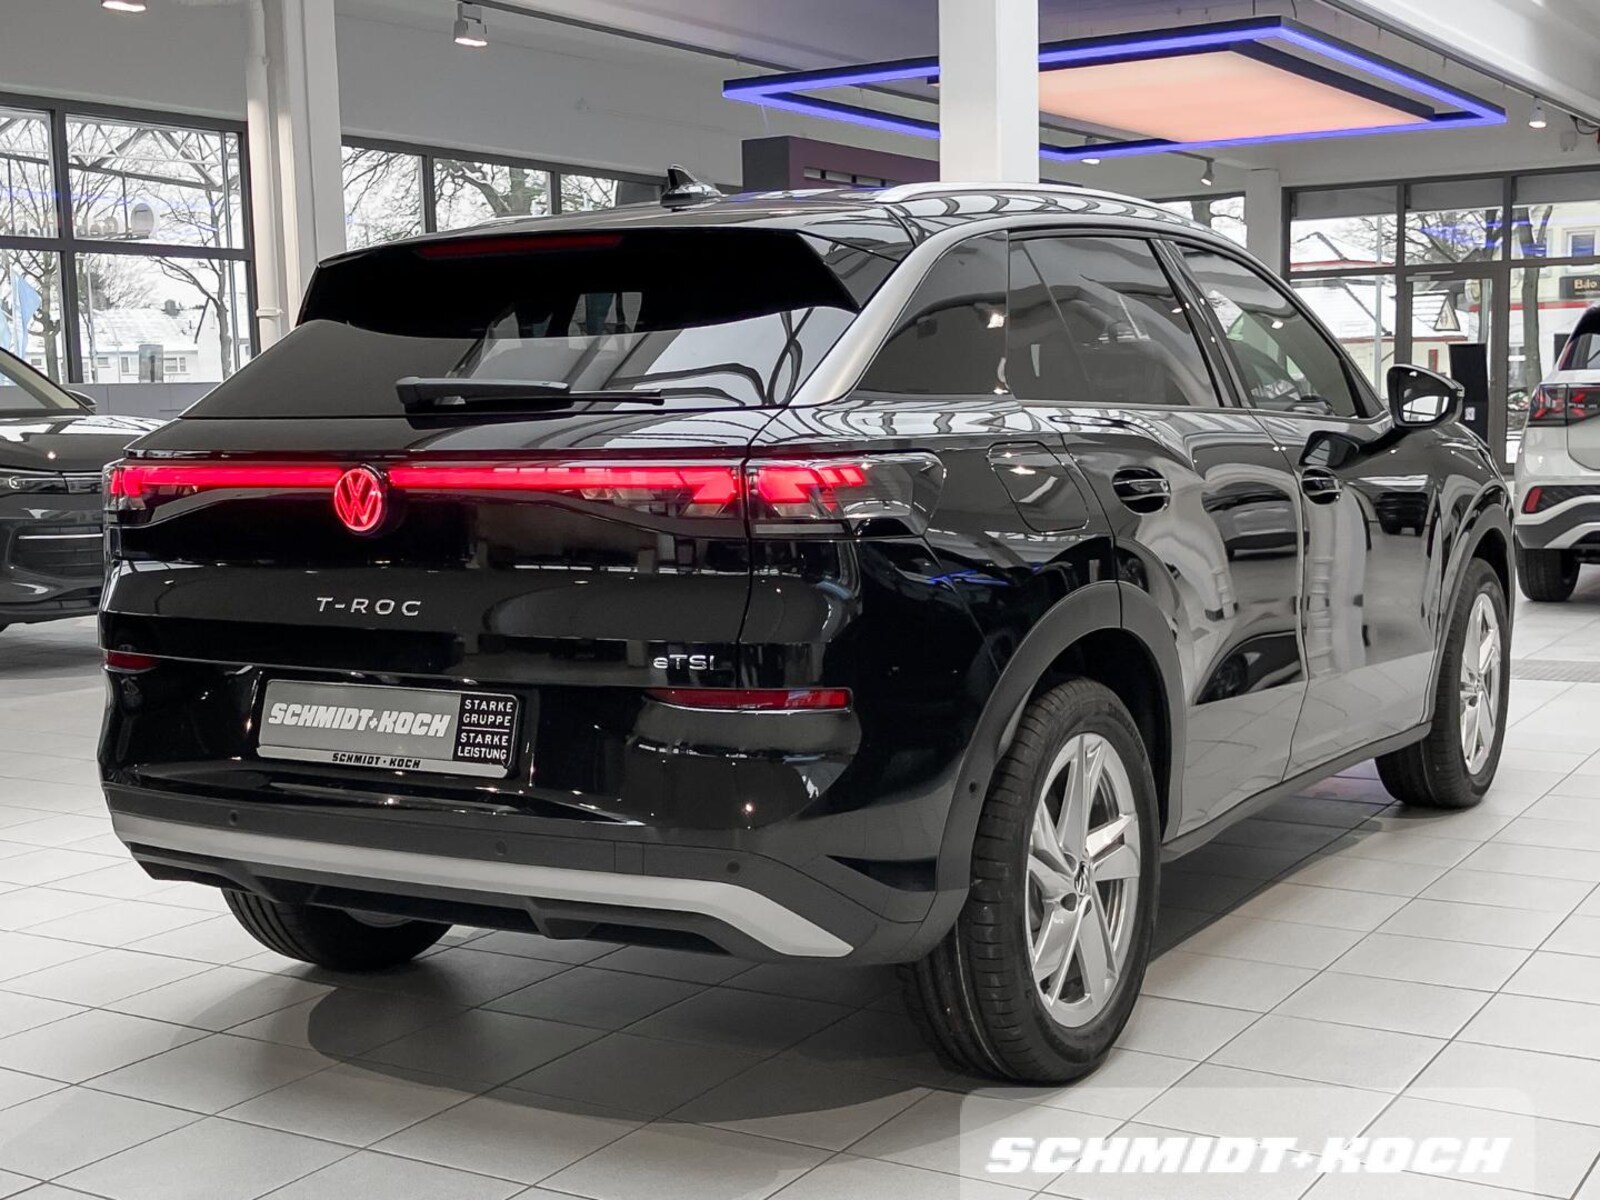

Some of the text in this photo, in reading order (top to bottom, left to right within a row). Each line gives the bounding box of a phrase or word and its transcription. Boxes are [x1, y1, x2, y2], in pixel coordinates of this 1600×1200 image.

[316, 596, 421, 616] T-ROC
[653, 654, 715, 671] eTSI
[464, 699, 514, 712] STARKE
[462, 713, 512, 726] GRUPPE
[460, 732, 509, 746] STARKE
[457, 746, 507, 760] LEISTUNG
